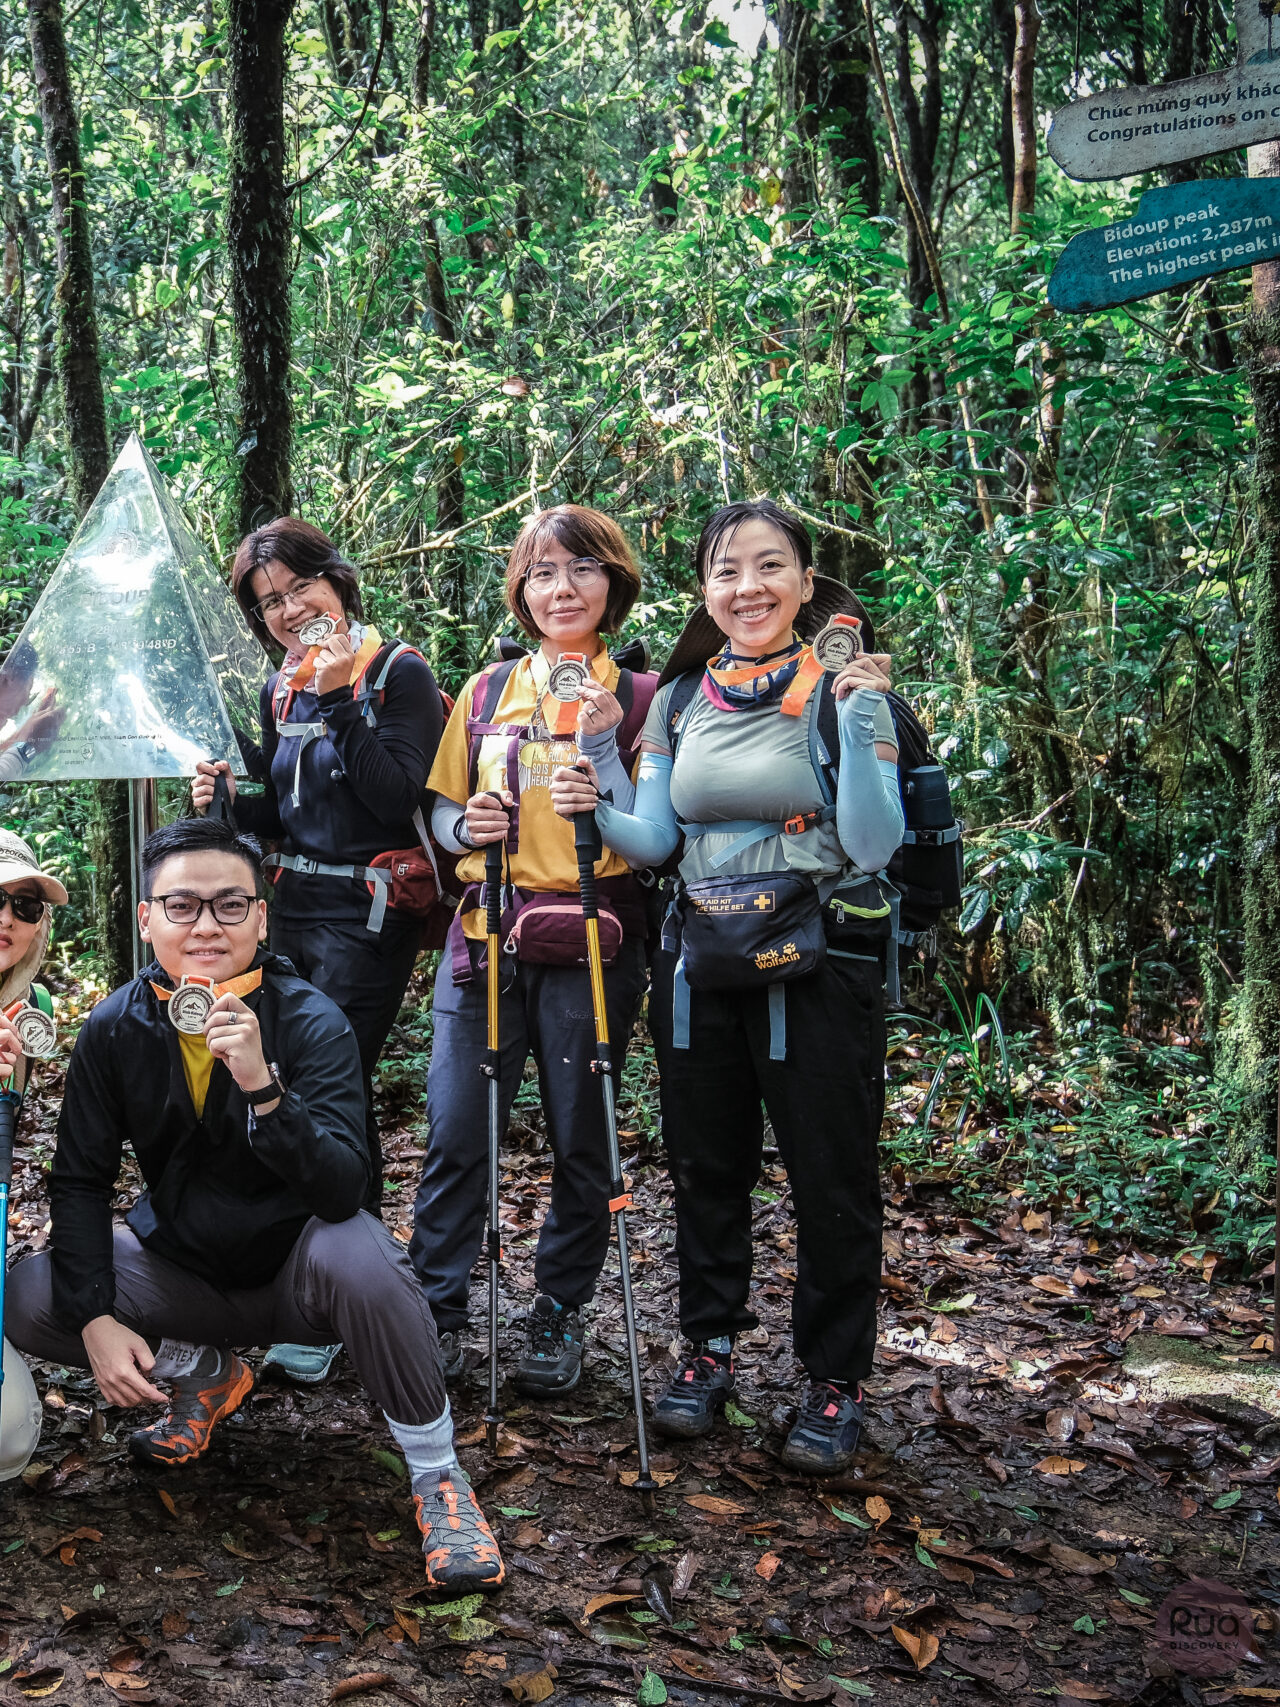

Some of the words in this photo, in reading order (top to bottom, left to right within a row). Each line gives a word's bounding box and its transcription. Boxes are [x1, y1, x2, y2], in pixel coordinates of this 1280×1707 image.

[1088, 103, 1133, 121] Chúc
[1195, 87, 1232, 109] quý
[1087, 112, 1237, 143] Congratulations
[1241, 109, 1266, 122] on
[1104, 218, 1170, 243] Bidoup
[1173, 203, 1221, 230] peak
[1106, 233, 1198, 264] Elevation:
[1201, 215, 1273, 242] 2,287m
[1108, 267, 1143, 284] The
[1146, 249, 1218, 276] highest
[1220, 235, 1269, 263] peak
[532, 763, 541, 774] SO
[542, 763, 549, 775] IS
[709, 904, 730, 912] HILFE
[731, 903, 746, 911] SET
[754, 948, 780, 963] Jack
[755, 952, 800, 970] Wolfskin
